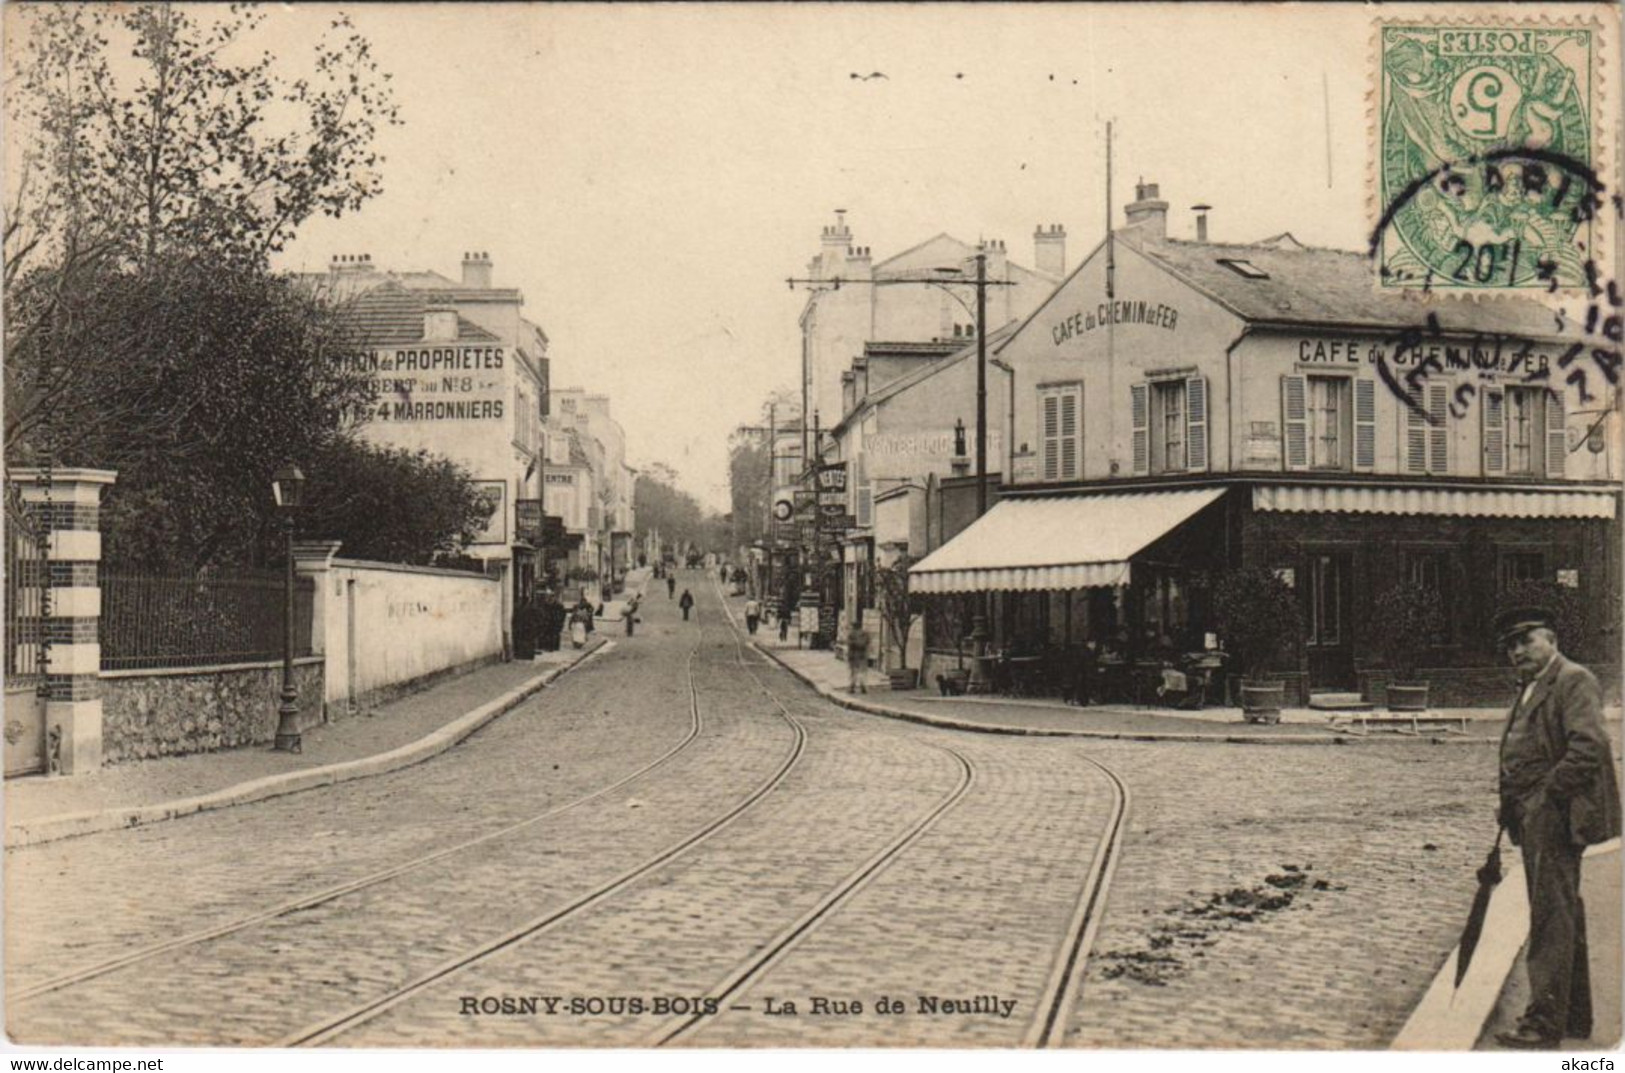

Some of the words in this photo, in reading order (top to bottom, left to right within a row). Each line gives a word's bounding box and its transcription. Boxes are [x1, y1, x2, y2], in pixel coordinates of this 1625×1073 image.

[1443, 32, 1532, 53] POSTES
[1098, 301, 1147, 326] CHEMIN
[1155, 303, 1179, 331] FER
[1511, 352, 1549, 374] FER
[377, 401, 391, 420] 4
[395, 400, 504, 421] MARRONNIERS
